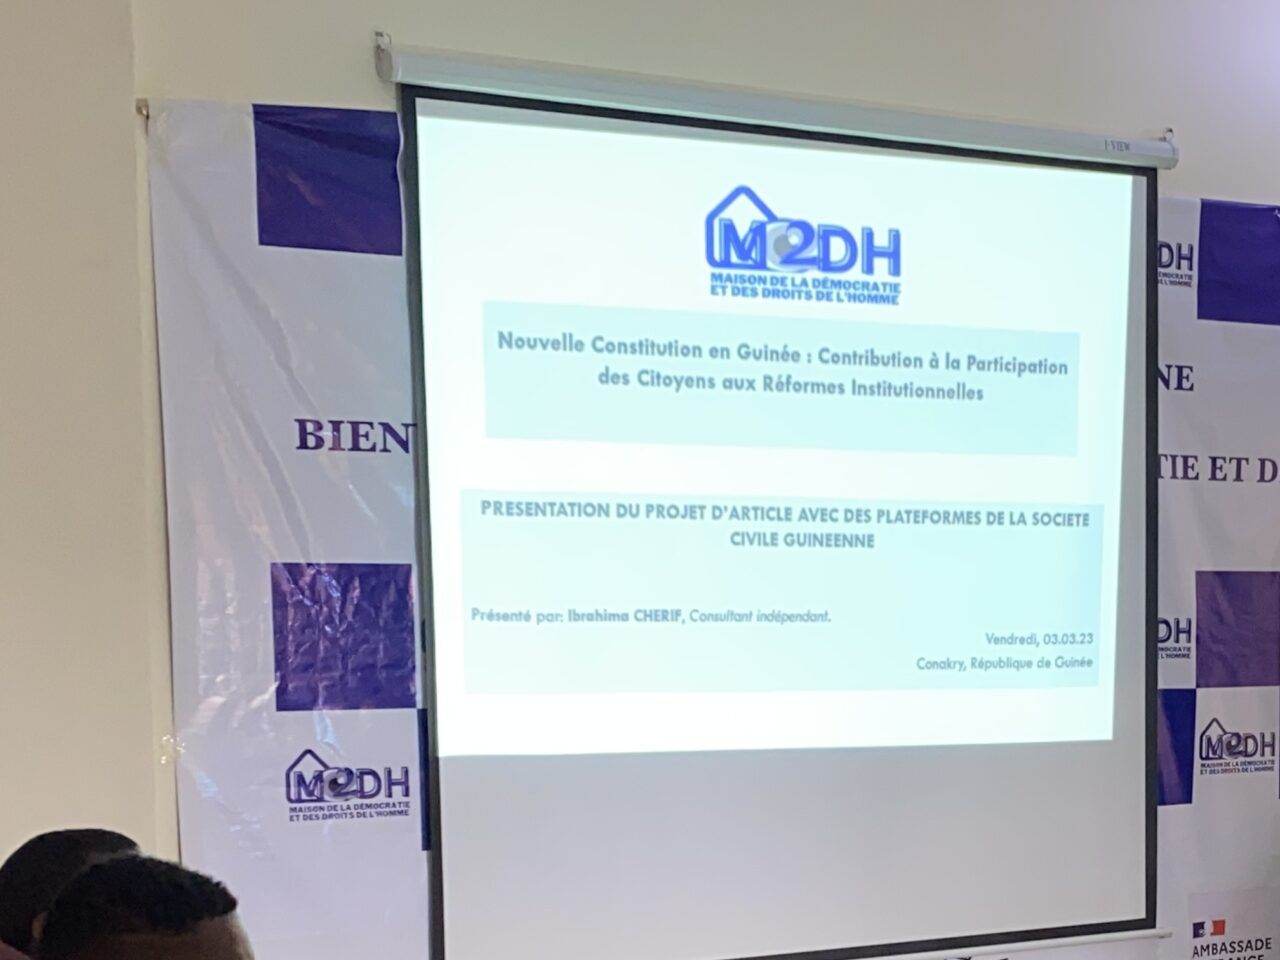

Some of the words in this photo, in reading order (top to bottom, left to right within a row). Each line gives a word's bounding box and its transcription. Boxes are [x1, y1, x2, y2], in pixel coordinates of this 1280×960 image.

[710, 272, 768, 287] MAISON
[769, 275, 789, 288] DE
[791, 276, 810, 289] LA
[710, 284, 729, 296] ET
[731, 286, 759, 298] DES
[762, 287, 814, 302] DROITS
[815, 290, 834, 303] DE
[836, 291, 900, 306] L'HOMME
[498, 330, 585, 352] Nouvelle
[591, 335, 703, 359] Constitution
[708, 345, 731, 360] en
[737, 342, 801, 364] Guinée
[818, 347, 923, 370] Contribution
[928, 352, 940, 370] à
[945, 352, 961, 371] la
[967, 355, 1068, 378] Participation
[598, 366, 631, 386] des
[637, 368, 716, 392] Citoyens
[722, 377, 757, 392] aux
[763, 373, 846, 396] Réformes
[851, 379, 984, 401] Institutionnelles
[294, 418, 417, 454] BIEN
[1208, 456, 1249, 482] ET
[480, 500, 610, 518] PRESENTATION
[616, 503, 641, 519] DU
[645, 503, 707, 520] PROJET
[711, 505, 793, 522] D'ARTICLE
[798, 507, 839, 523] AVEC
[843, 508, 872, 524] DES
[876, 509, 982, 526] PLATEFORMES
[986, 511, 1005, 526] DE
[1008, 511, 1027, 526] LA
[1031, 512, 1090, 528] SOCIETE
[730, 531, 779, 547] CIVILE
[783, 532, 875, 549] GUINEENNE
[471, 607, 532, 623] Présenté
[536, 611, 564, 625] par:
[568, 608, 630, 623] Ibrahima
[633, 609, 686, 625] CHERIF,
[689, 608, 753, 623] Consultant
[756, 609, 832, 625] indépendant.
[985, 632, 1040, 648] Vendredi,
[1043, 632, 1094, 645] 03.03.23
[916, 657, 967, 673] Conakry,
[970, 656, 1033, 673] République
[1037, 656, 1052, 670] de
[1055, 655, 1094, 670] Guinée
[289, 805, 326, 814] MAISON
[327, 804, 339, 812] DE
[340, 803, 352, 811] LA
[289, 814, 301, 822] ET
[302, 813, 320, 822] DES
[321, 811, 355, 821] DROITS
[356, 810, 369, 819] DE
[1192, 937, 1272, 959] AMBASSADE
